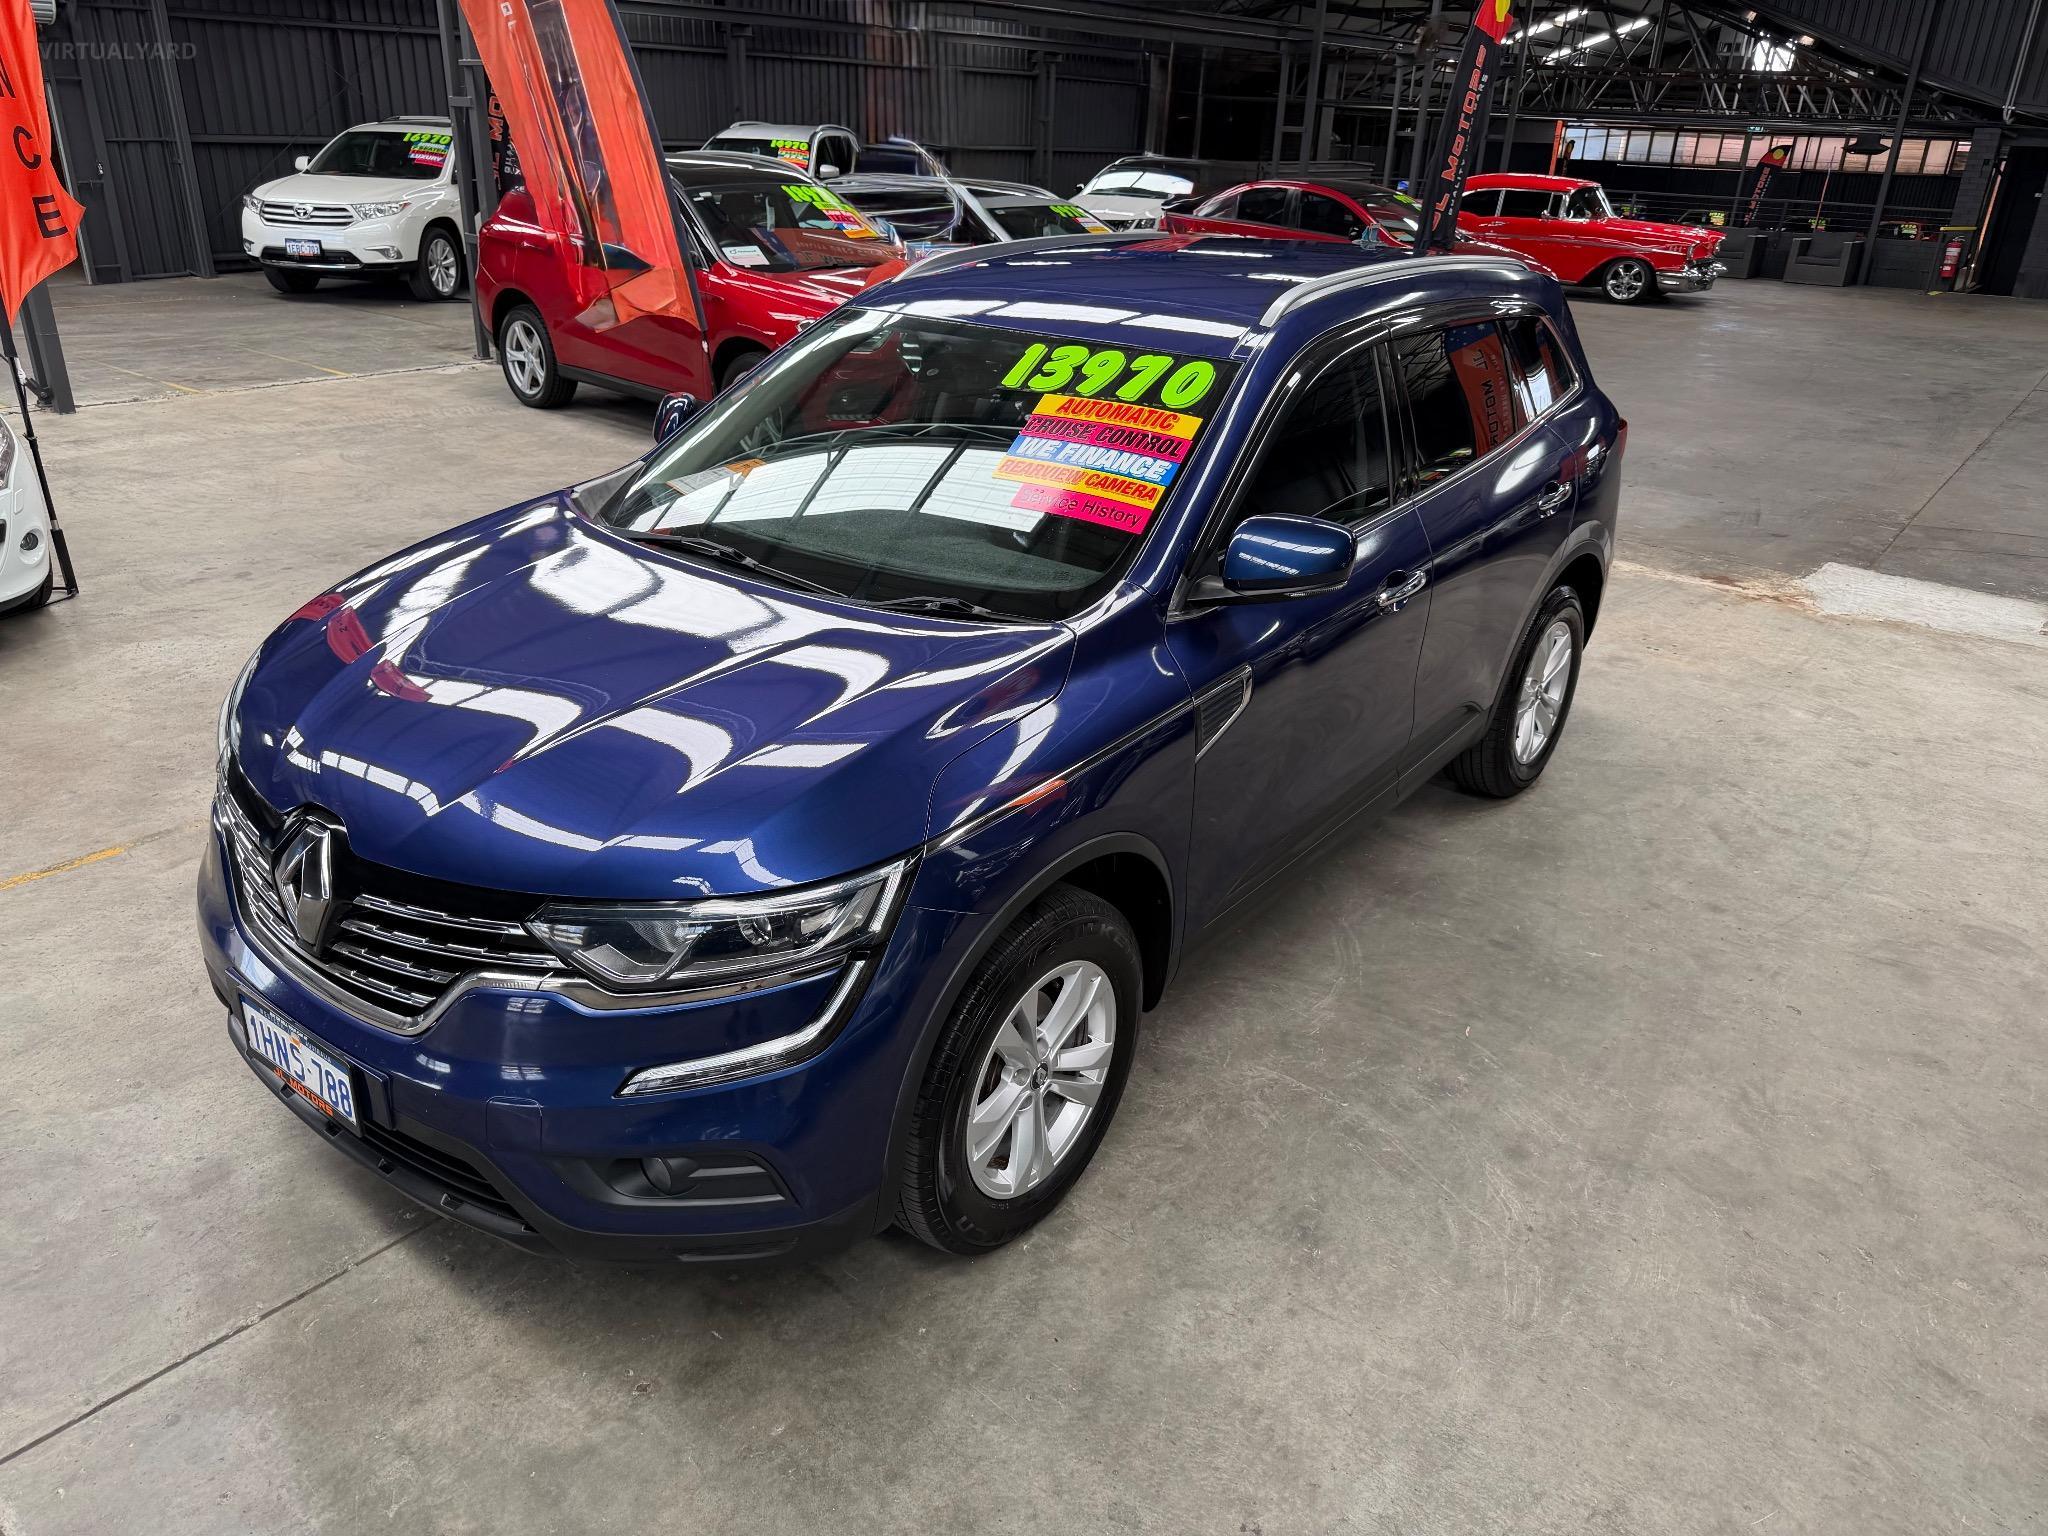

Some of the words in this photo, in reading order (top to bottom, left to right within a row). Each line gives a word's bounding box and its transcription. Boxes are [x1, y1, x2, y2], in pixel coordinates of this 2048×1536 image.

[1441, 44, 1487, 182] MOTORS
[411, 153, 444, 162] LUXURY
[1001, 343, 1216, 409] 13970
[1055, 398, 1181, 431] AUTOMATIC
[1025, 417, 1094, 441] CRUISE
[1095, 426, 1185, 458] CONTROL
[1017, 437, 1063, 458] WE
[1058, 442, 1173, 480] FINANCE
[999, 459, 1087, 486] REARVIEW
[1083, 474, 1160, 503] CAMERA
[1022, 488, 1079, 511] Service
[1081, 498, 1142, 527] History
[289, 1077, 334, 1116] MOTORS
